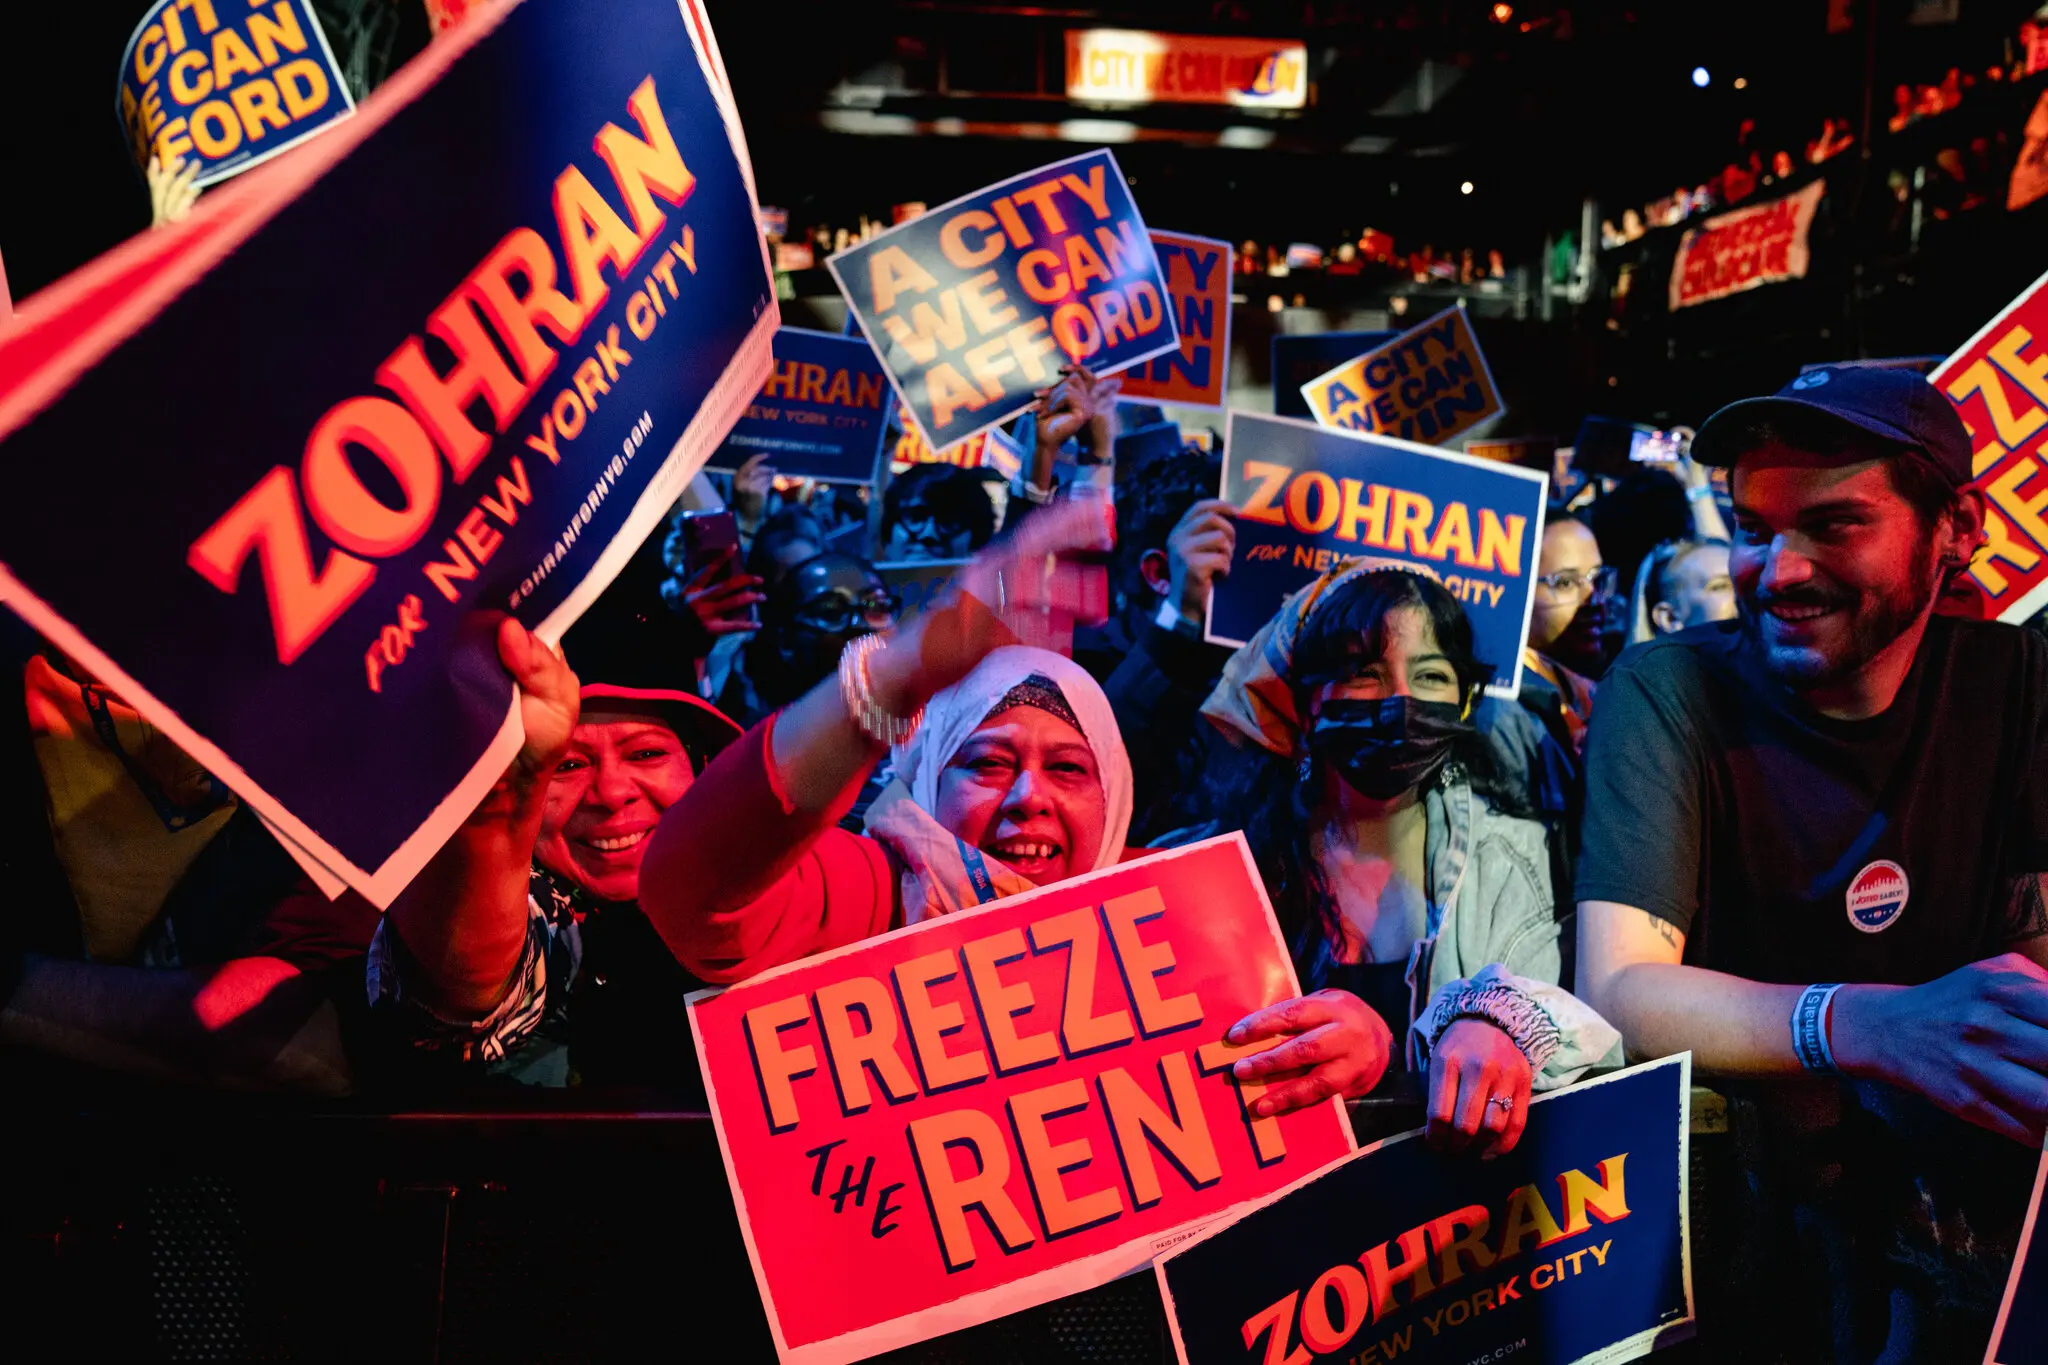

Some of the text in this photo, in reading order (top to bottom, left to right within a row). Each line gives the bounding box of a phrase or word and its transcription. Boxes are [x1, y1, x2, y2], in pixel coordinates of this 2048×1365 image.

[134, 0, 268, 85] CIT
[168, 0, 308, 106] CAN
[150, 58, 330, 171] FORD
[868, 165, 1111, 316] A CITY
[881, 269, 1019, 366] WE
[1017, 220, 1148, 305] CAN
[1153, 242, 1218, 291] TY
[187, 74, 696, 665] ZOHRAN
[763, 357, 884, 410] HRAN
[925, 280, 1163, 430] AFFORD
[1327, 381, 1360, 416] A
[1364, 318, 1456, 389] CITY
[1337, 391, 1398, 433] WE
[1400, 351, 1474, 410] CAN
[365, 594, 428, 692] FOR
[422, 455, 533, 602] NEW
[526, 323, 632, 465] YORK
[625, 224, 697, 341] CITY
[785, 409, 828, 426] YORK
[509, 410, 654, 609] ZOHRANFORNYC.COM
[1237, 459, 1527, 577] ZOHRAN
[1967, 440, 2048, 600] RE
[1246, 543, 1287, 563] FOR
[1445, 574, 1506, 609] CITY
[742, 885, 1204, 1136] FREEZE
[1807, 995, 1820, 1004] 5
[804, 1139, 906, 1239] THE
[905, 1033, 1287, 1275] RENT
[1156, 1240, 1172, 1249] PAID
[1173, 1234, 1187, 1243] FOR
[1241, 1151, 1632, 1365] ZOHRAN
[1349, 1239, 1614, 1365] EW YORK CITY
